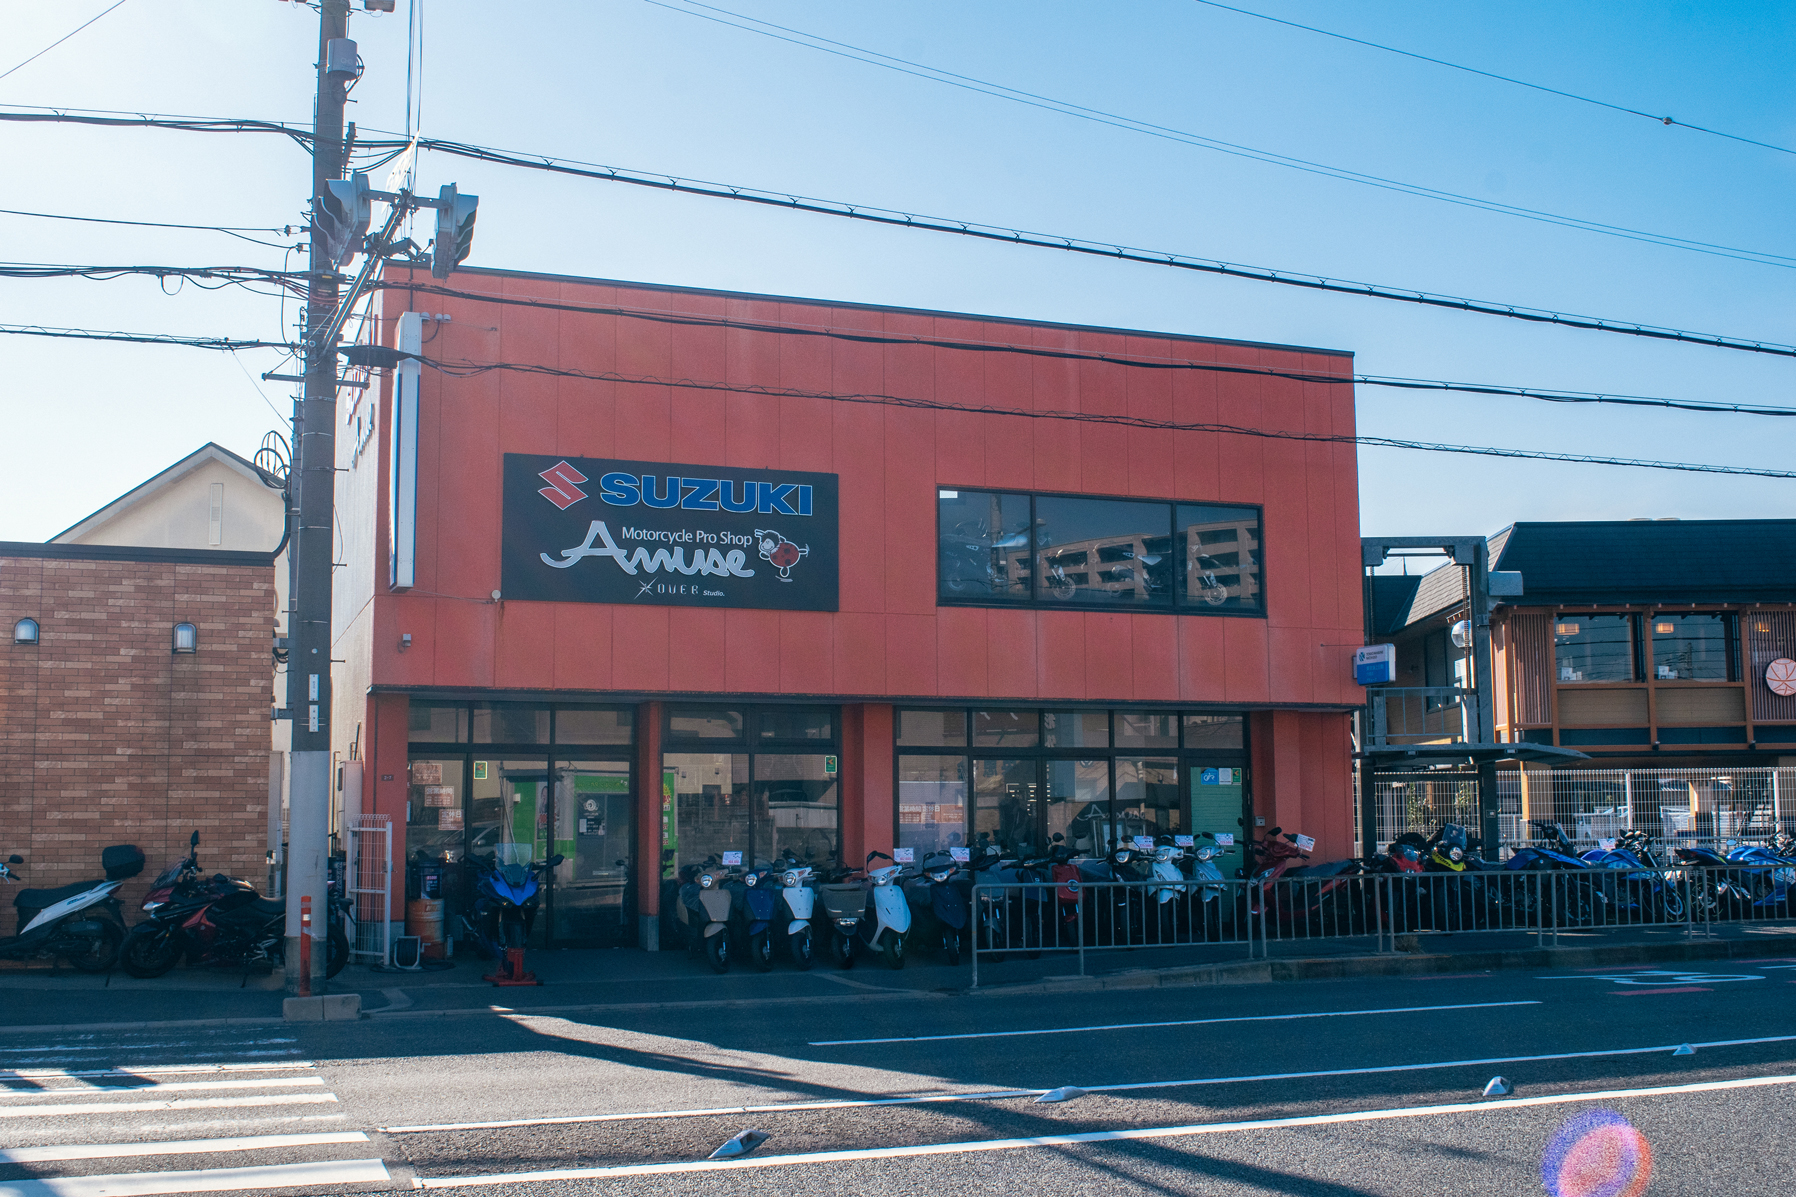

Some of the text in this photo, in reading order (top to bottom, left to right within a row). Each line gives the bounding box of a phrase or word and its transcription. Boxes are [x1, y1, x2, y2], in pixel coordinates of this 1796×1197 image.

[600, 471, 813, 516] SUZUKI
[539, 519, 755, 578] Amuse
[622, 526, 752, 548] Motorcycle Pro Shop
